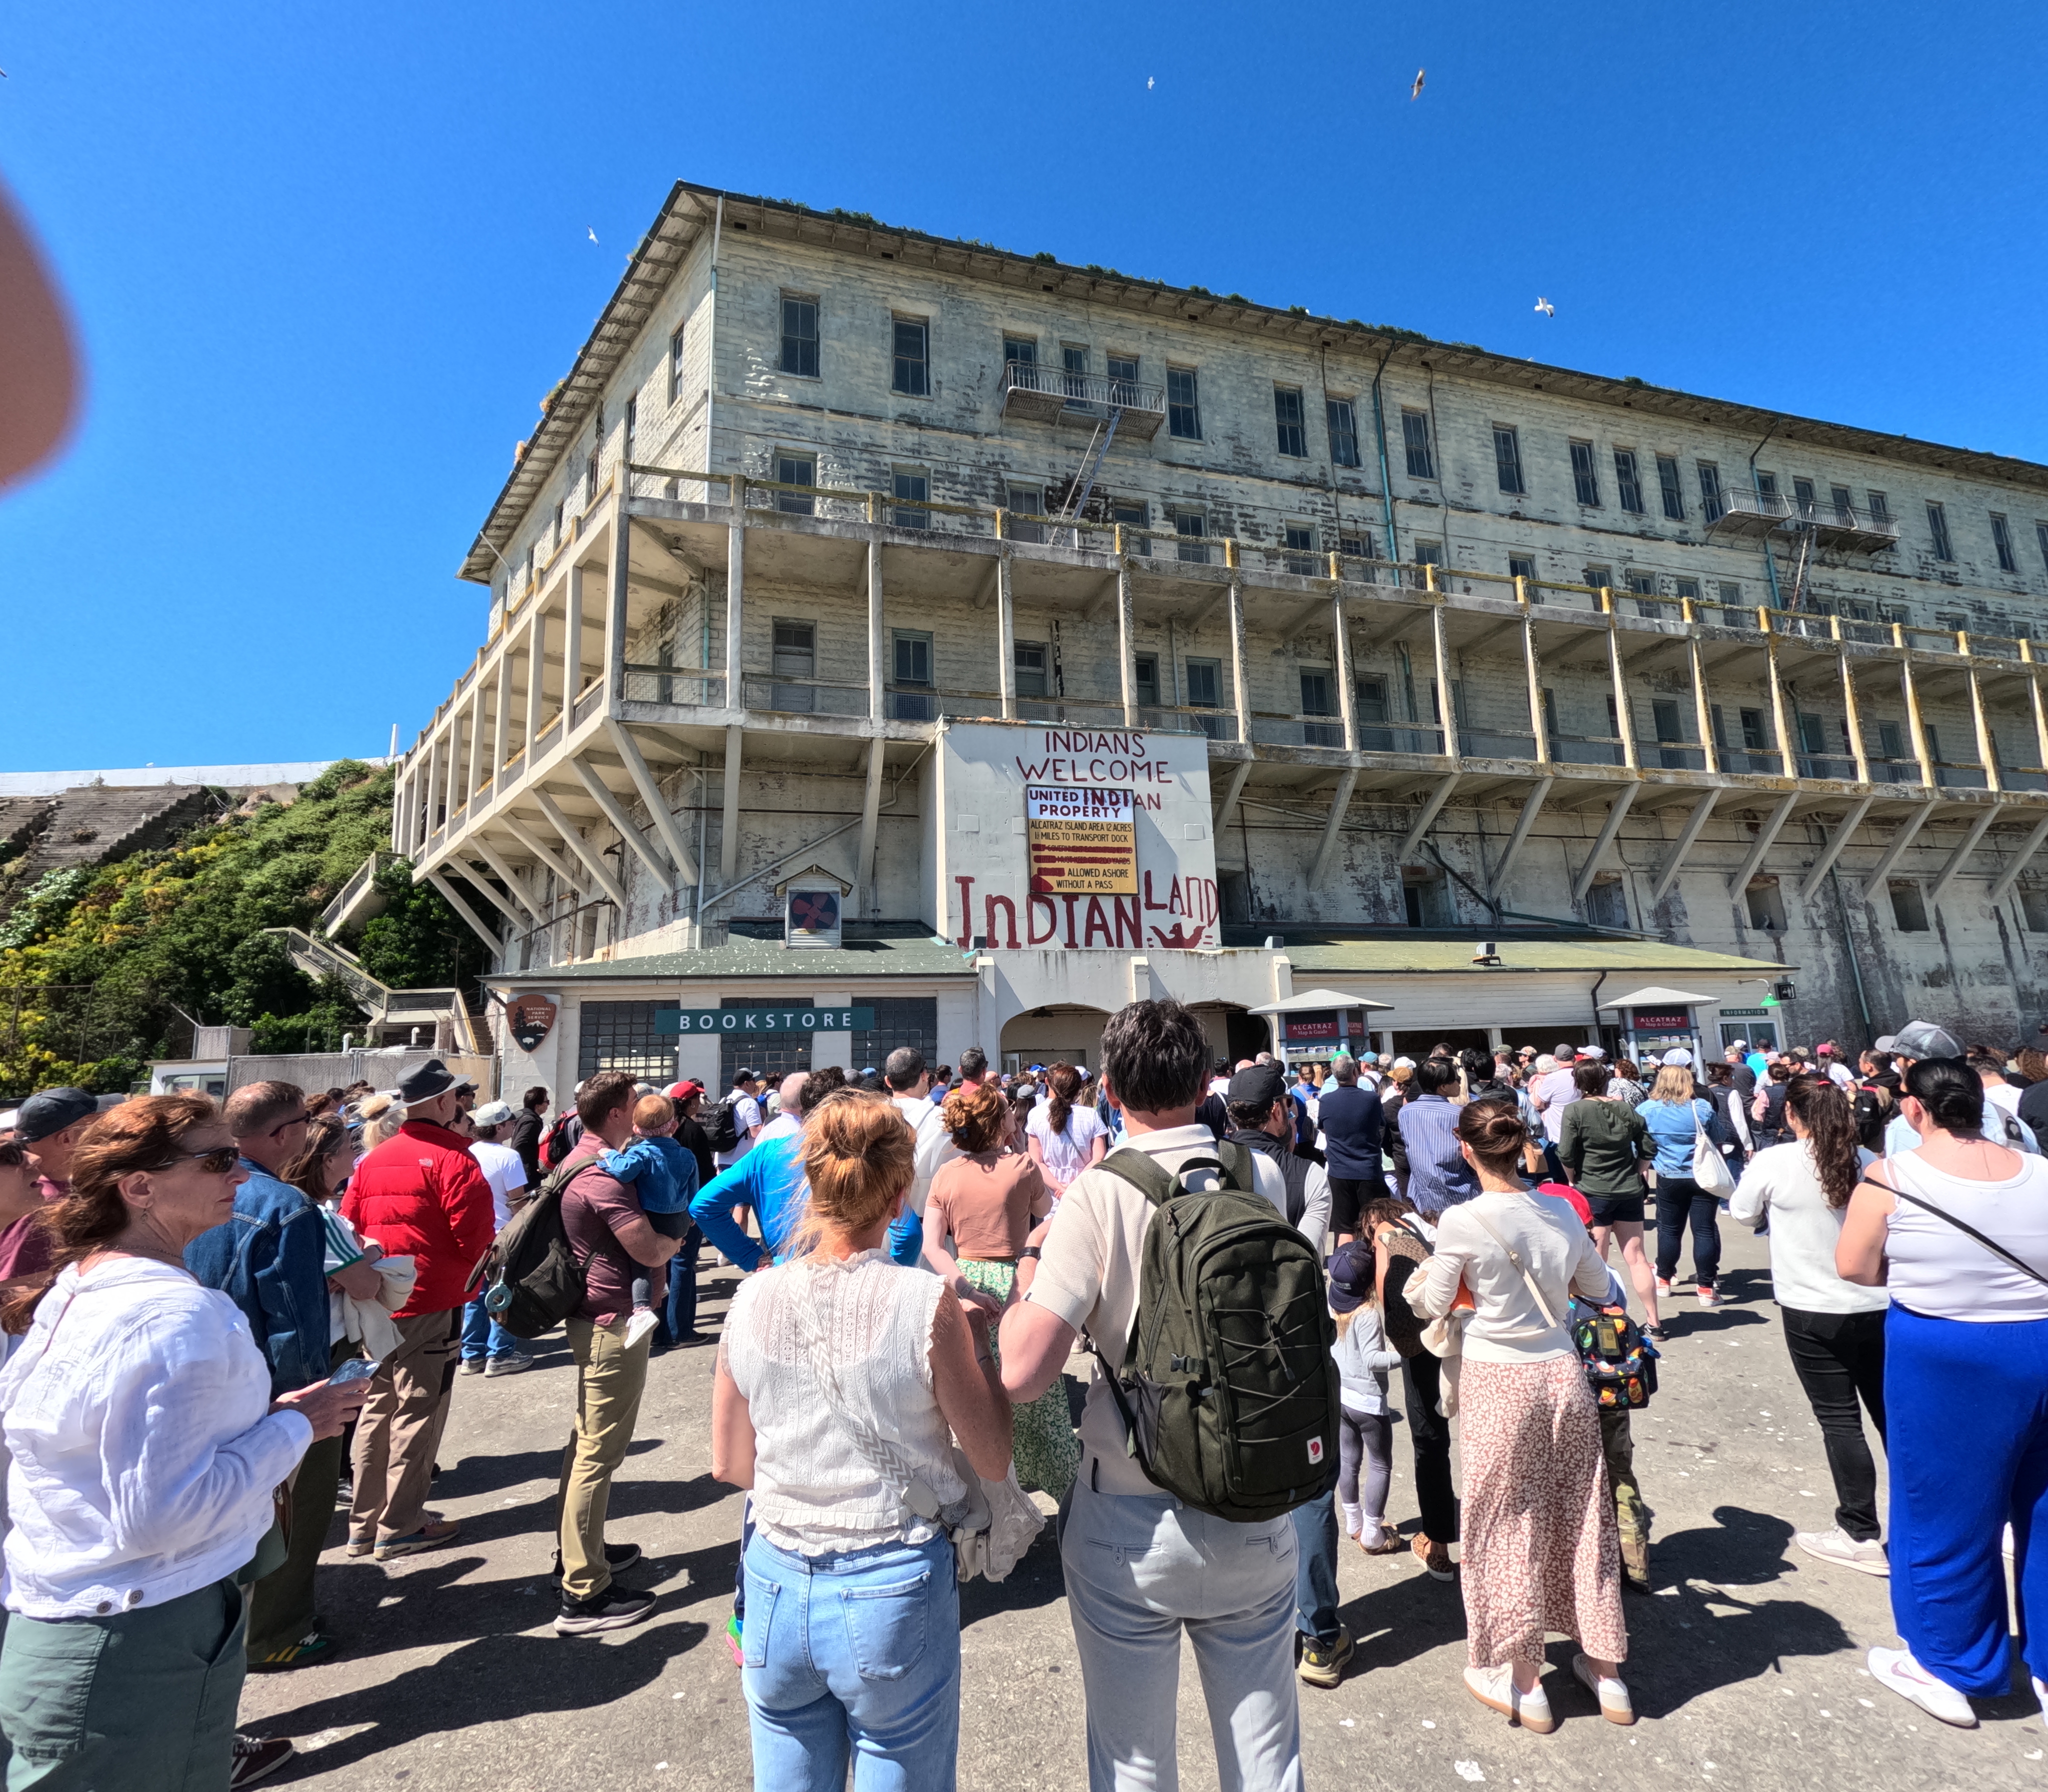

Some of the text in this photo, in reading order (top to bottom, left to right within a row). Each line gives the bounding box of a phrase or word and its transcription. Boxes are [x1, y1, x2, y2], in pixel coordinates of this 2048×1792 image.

[1045, 731, 1146, 758] INDIANS
[1016, 756, 1172, 784] WELCOME
[1030, 790, 1079, 802] UNITED
[1039, 804, 1121, 818] PROPERTY
[1030, 820, 1132, 832] ALCATRAZ ISLAND AREA 12 ACRES
[1041, 832, 1060, 840] MILES
[1072, 833, 1110, 842] TRANSPORT
[1112, 834, 1128, 842] DOCK
[1068, 868, 1129, 878] ALLOWED ASHORE
[1056, 880, 1113, 889] WITHOUT A PASS
[679, 1012, 851, 1030] BOOKSTORE
